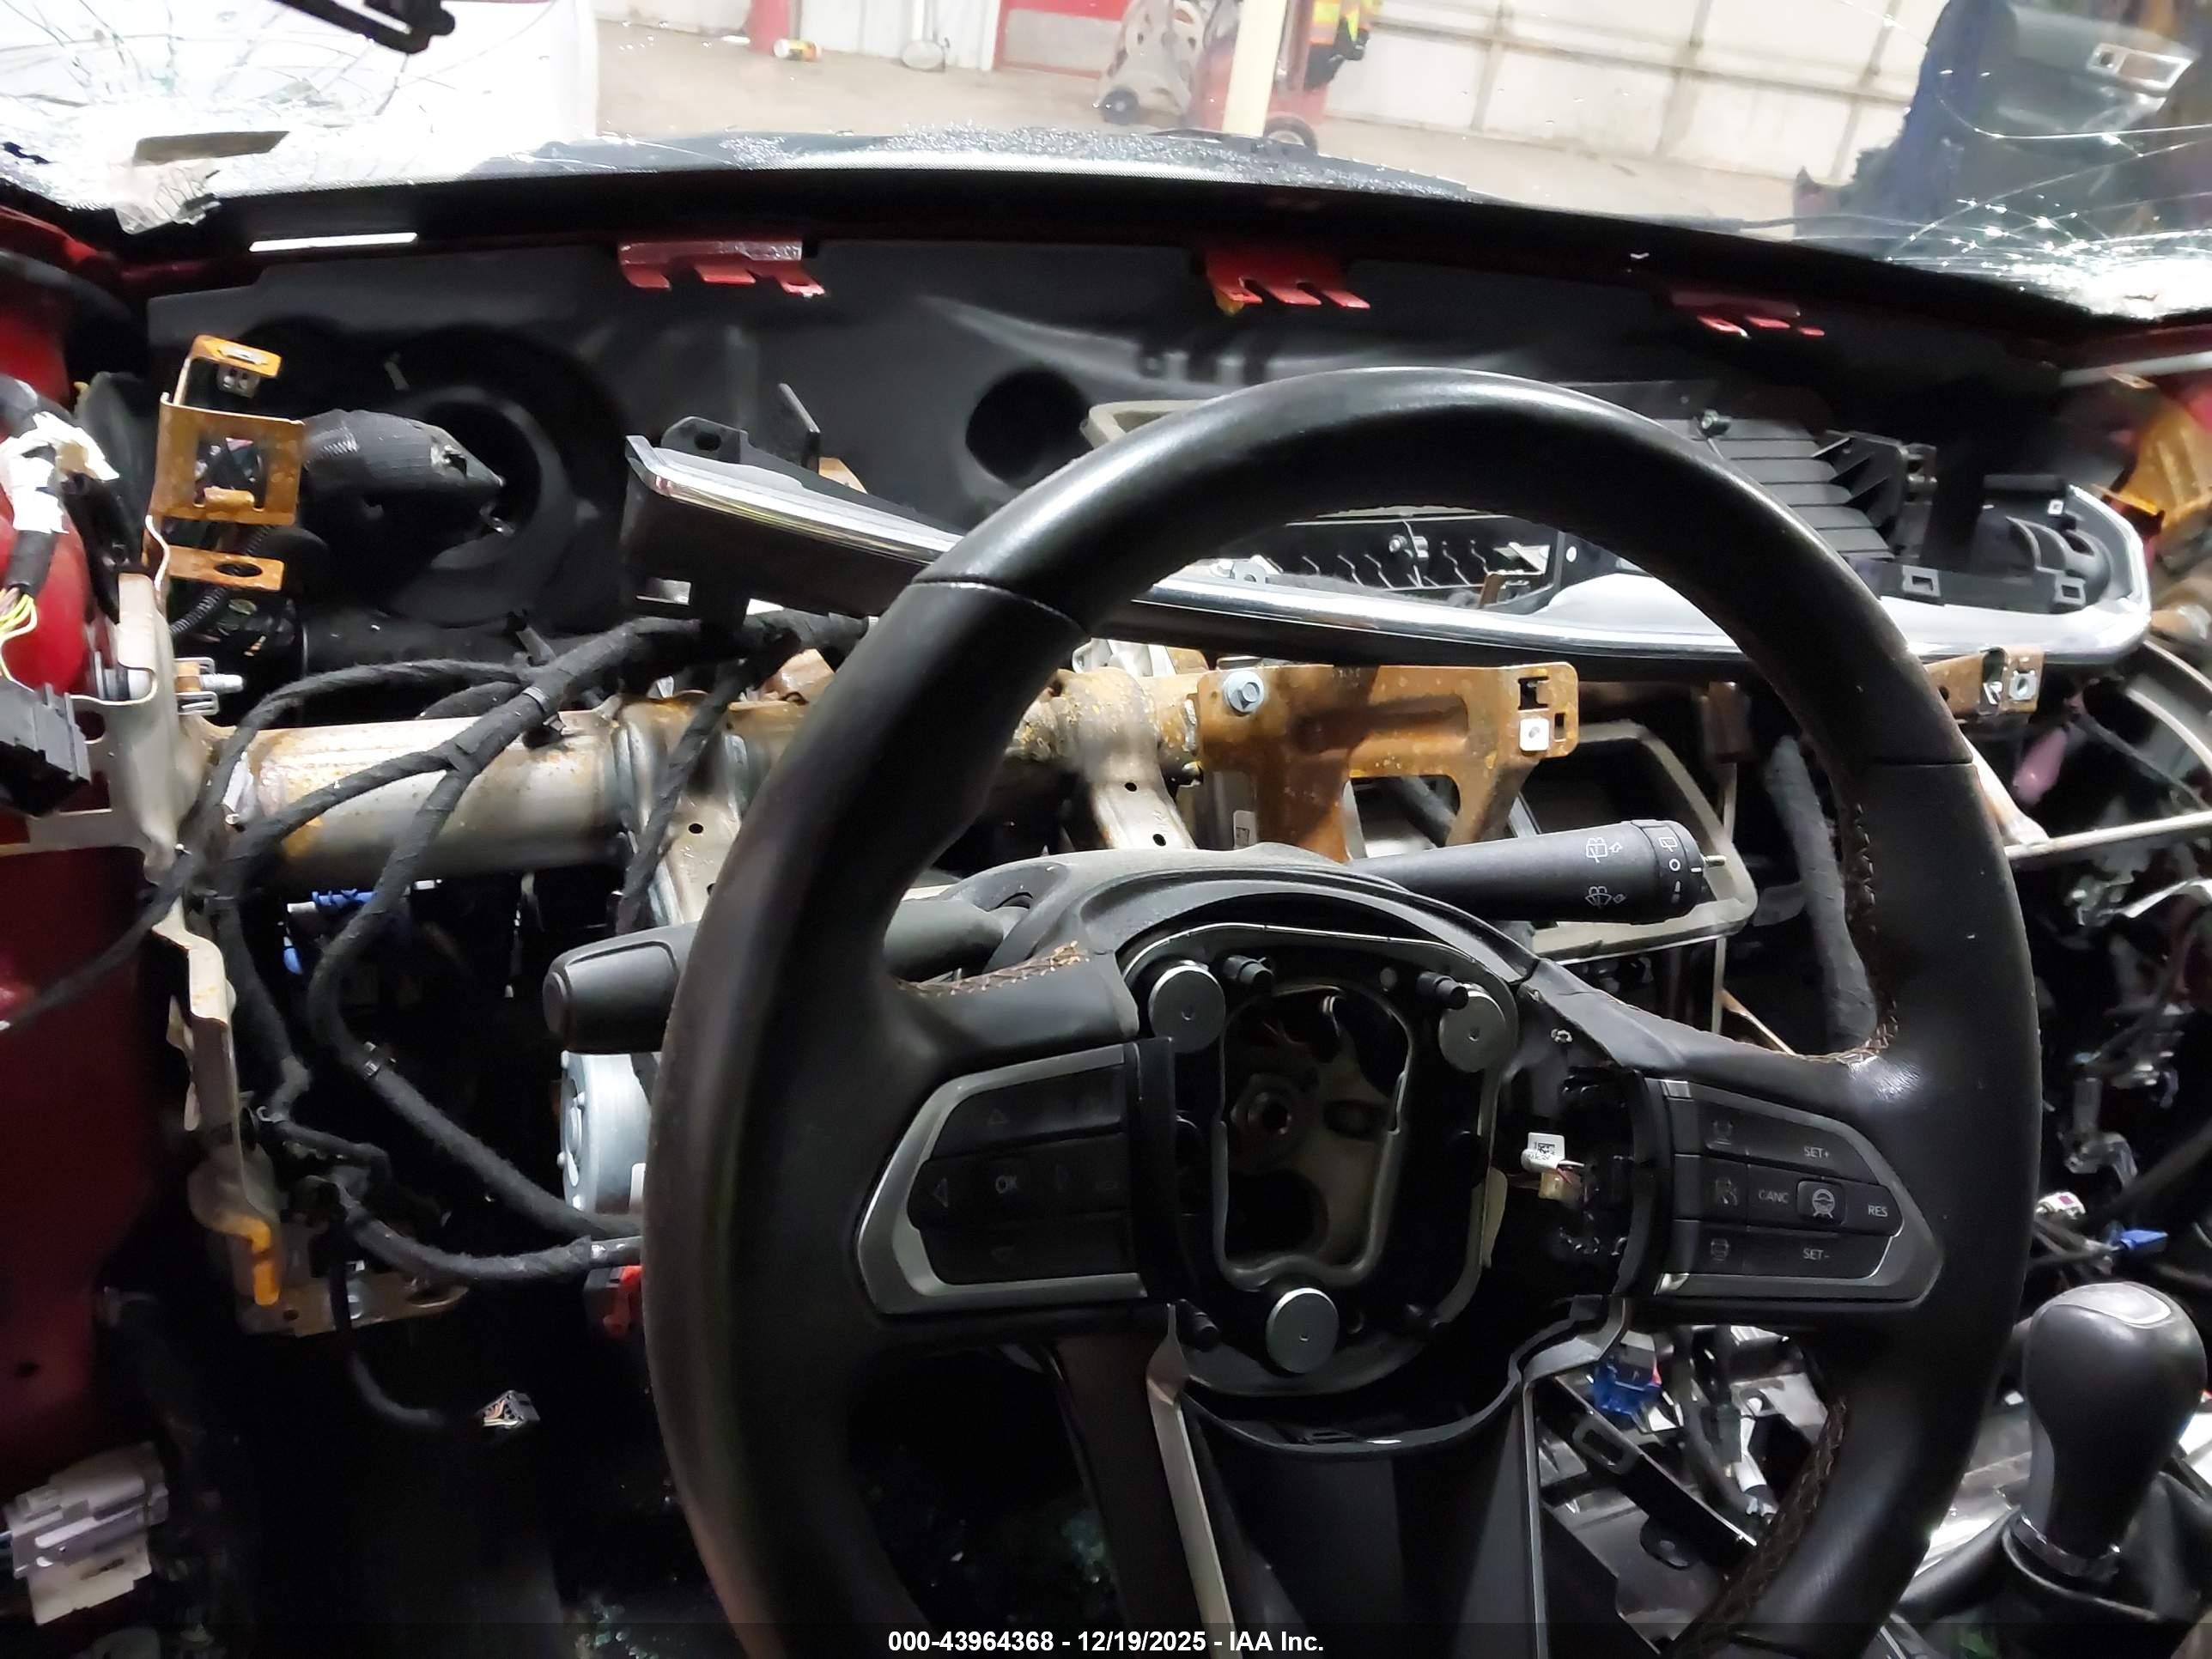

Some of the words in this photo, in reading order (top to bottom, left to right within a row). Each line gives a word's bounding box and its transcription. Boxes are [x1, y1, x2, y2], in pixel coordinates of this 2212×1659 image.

[1804, 1146, 1830, 1158] SET+
[1759, 1189, 1789, 1203] CANC
[1868, 1205, 1888, 1218] RES
[1803, 1248, 1830, 1261] SET-
